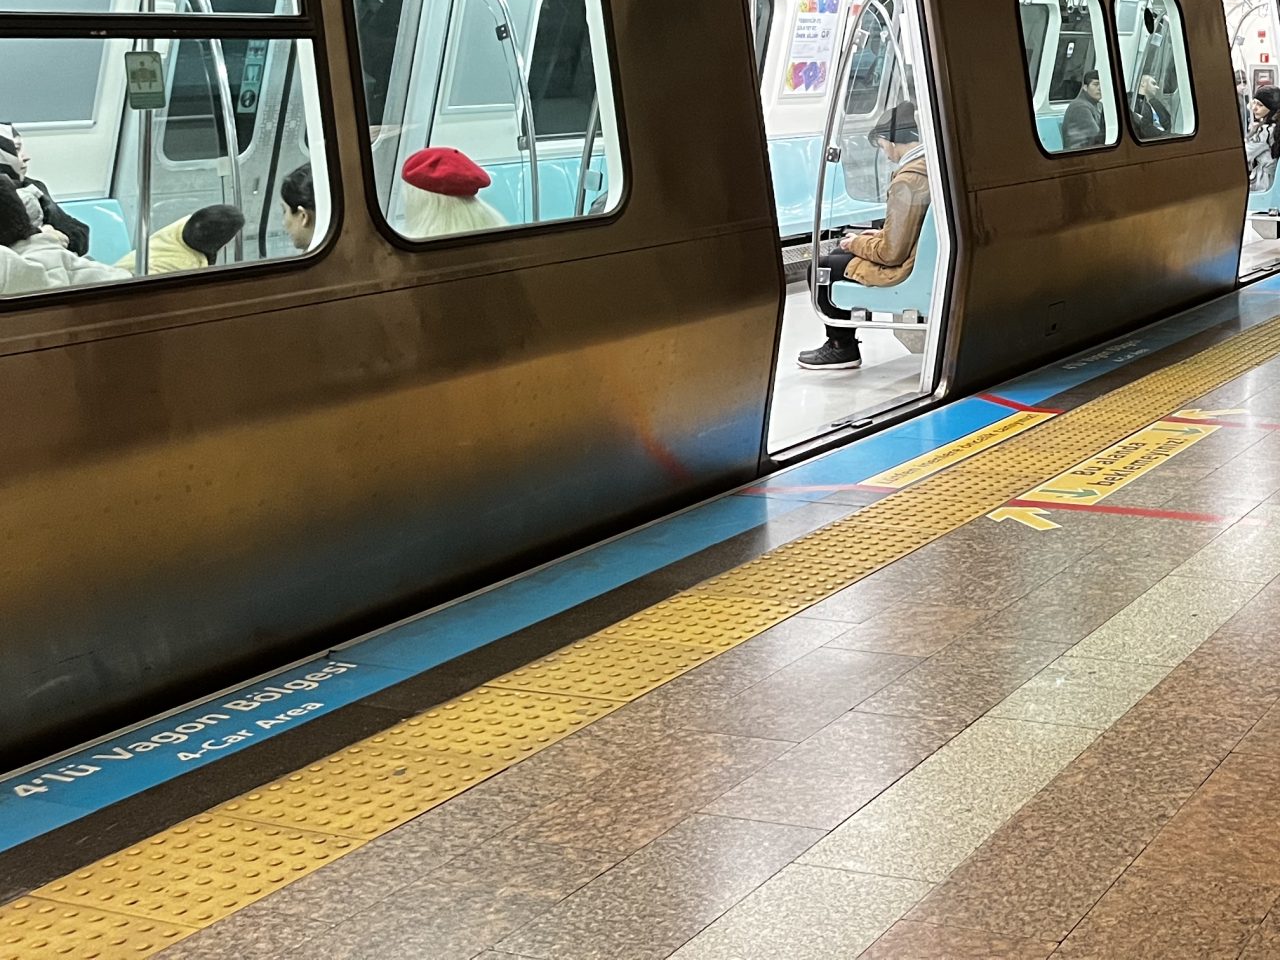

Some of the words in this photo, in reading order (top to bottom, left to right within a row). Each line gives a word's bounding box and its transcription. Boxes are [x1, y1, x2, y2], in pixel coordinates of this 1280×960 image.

[1070, 464, 1101, 477] Bu
[1096, 441, 1148, 467] alanda
[93, 711, 231, 761] Vagon
[223, 660, 358, 713] Bölgesi
[175, 727, 255, 763] 4-Car
[256, 700, 325, 731] Area
